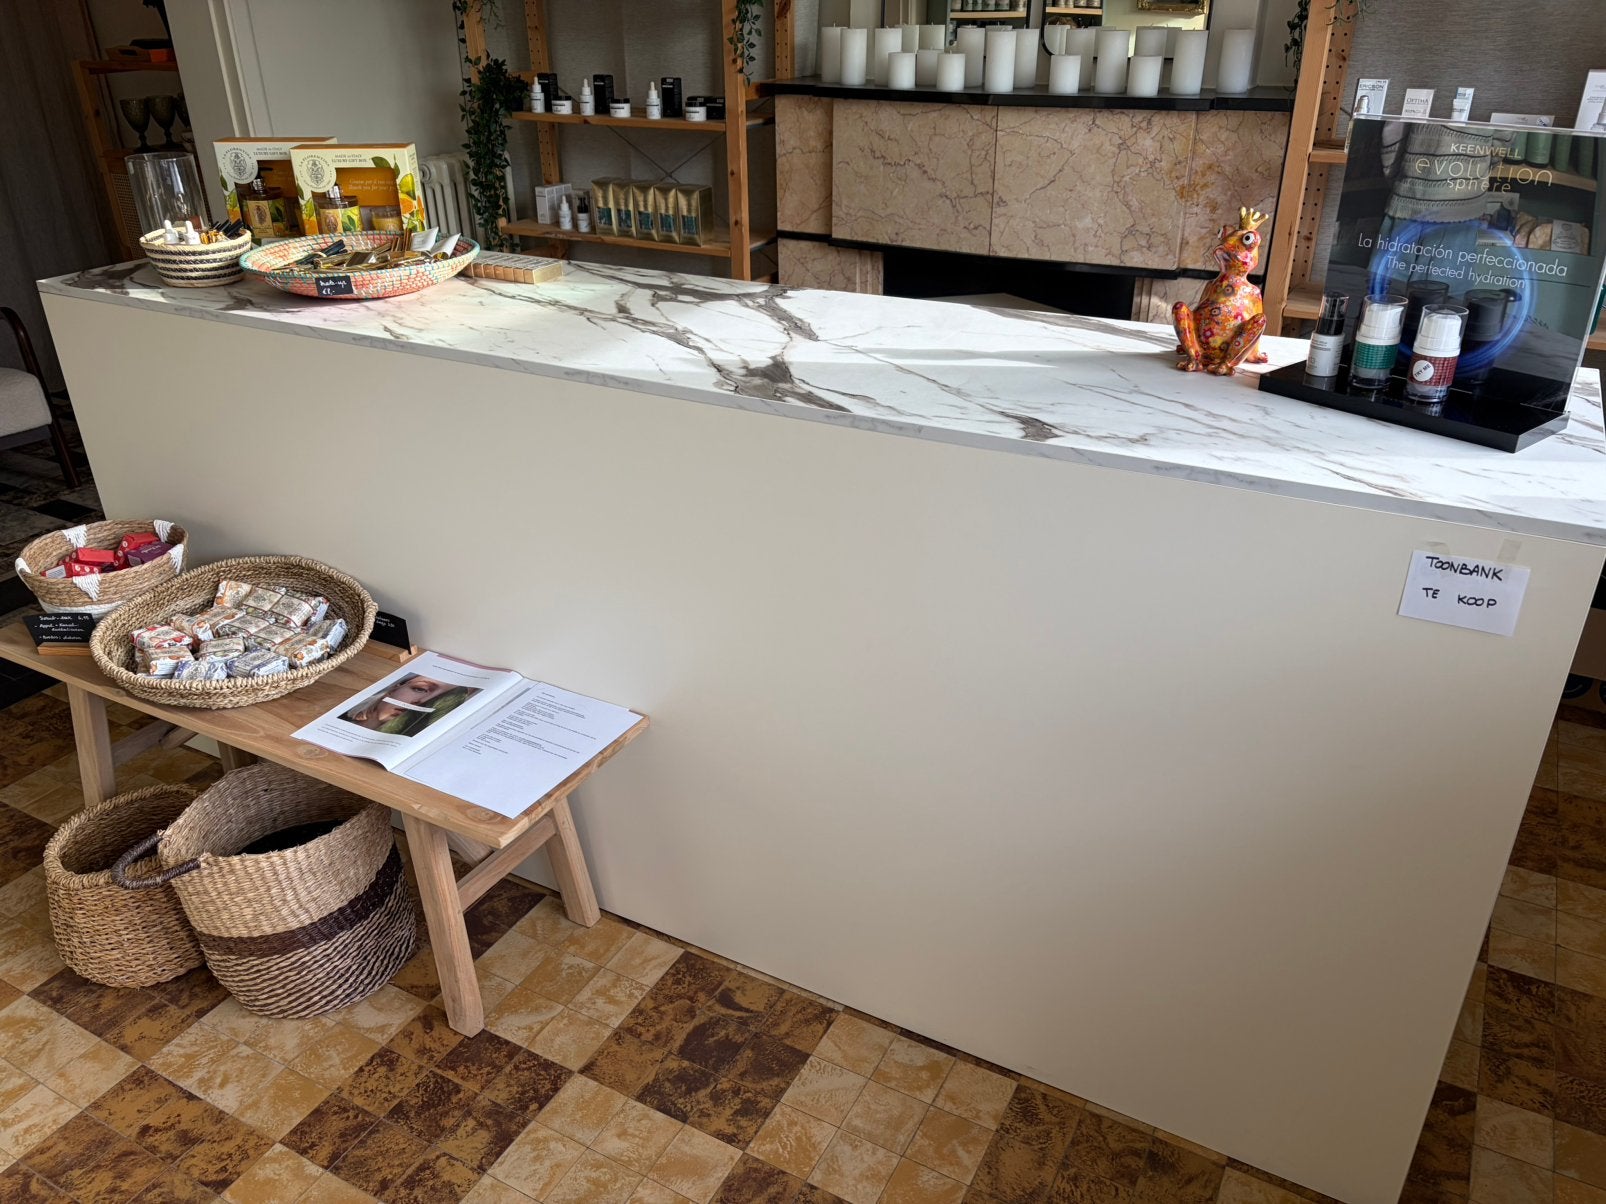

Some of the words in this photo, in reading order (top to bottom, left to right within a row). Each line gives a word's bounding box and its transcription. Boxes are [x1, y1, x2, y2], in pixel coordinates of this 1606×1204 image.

[1450, 143, 1521, 159] KEENWELL
[1415, 158, 1553, 187] evolution
[1447, 177, 1511, 194] sphere
[1358, 233, 1373, 248] La
[1377, 233, 1453, 260] hidratación
[1457, 248, 1568, 277] perfeccionada
[1387, 255, 1406, 270] The
[1409, 261, 1465, 279] perfected
[1468, 267, 1526, 289] hydration
[1425, 555, 1504, 582] TOONBANK
[1422, 587, 1440, 599] TE
[1457, 594, 1497, 608] KOOP
